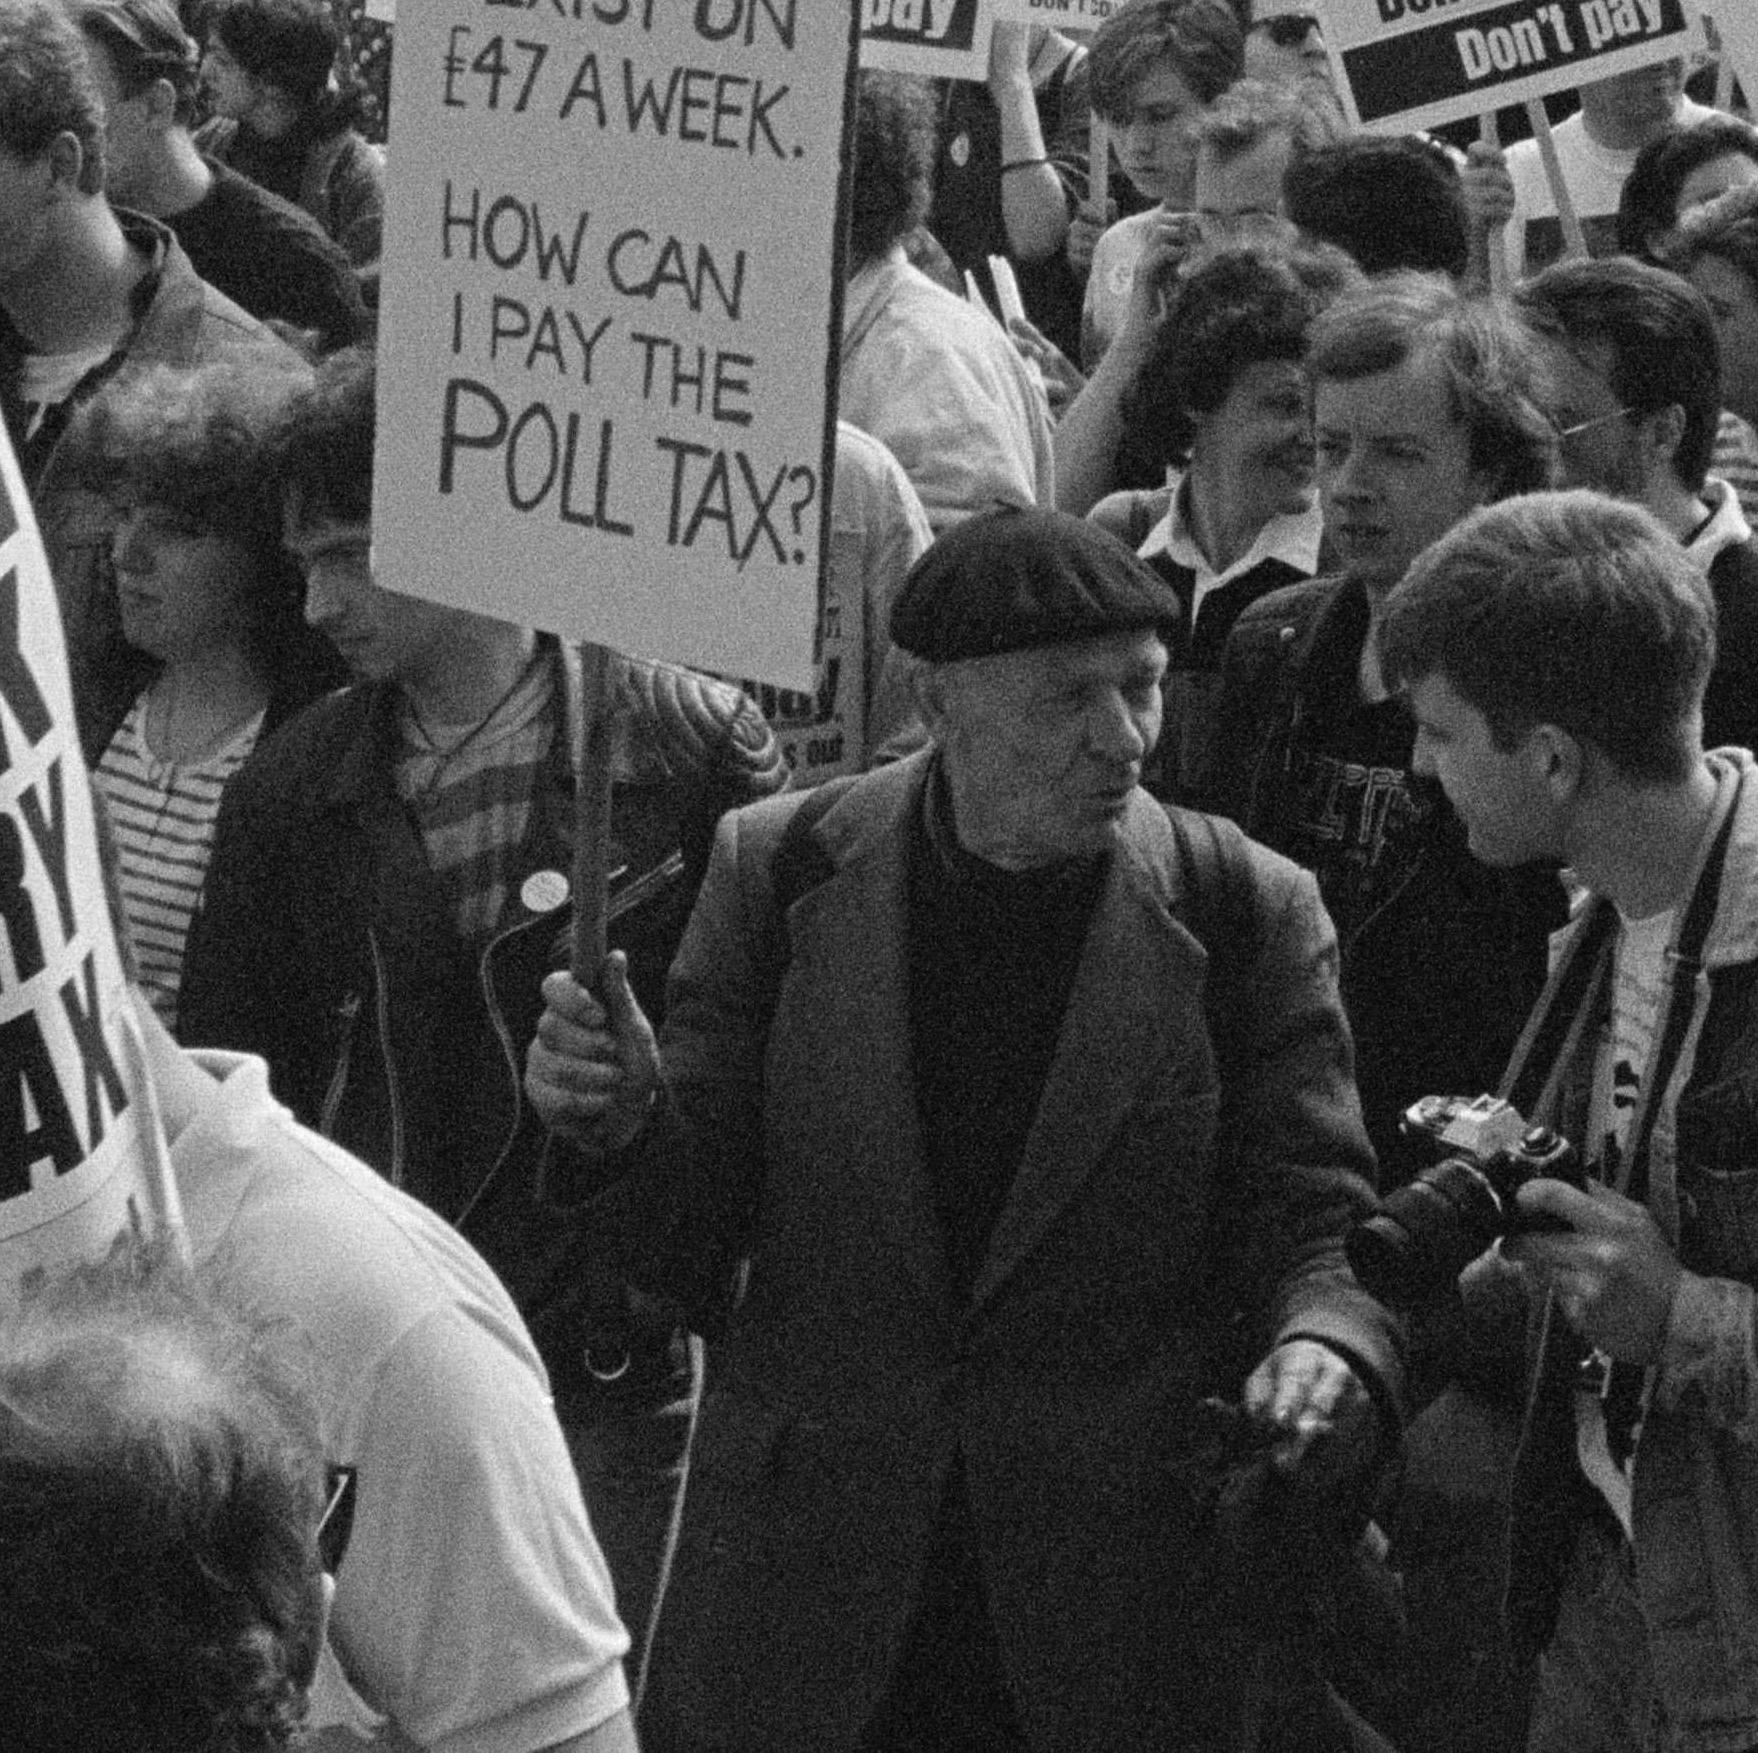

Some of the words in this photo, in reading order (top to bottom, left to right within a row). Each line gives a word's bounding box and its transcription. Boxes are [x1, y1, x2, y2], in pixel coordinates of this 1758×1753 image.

[442, 24, 550, 116] £47
[625, 57, 805, 161] WEEK.
[1454, 0, 1574, 83] Don't
[442, 179, 589, 287] HOW
[606, 227, 747, 321] CAN
[451, 291, 464, 355] I
[489, 296, 613, 386] PAY
[632, 330, 756, 427] THE
[438, 377, 636, 536] POLL
[655, 436, 818, 573] TAX?
